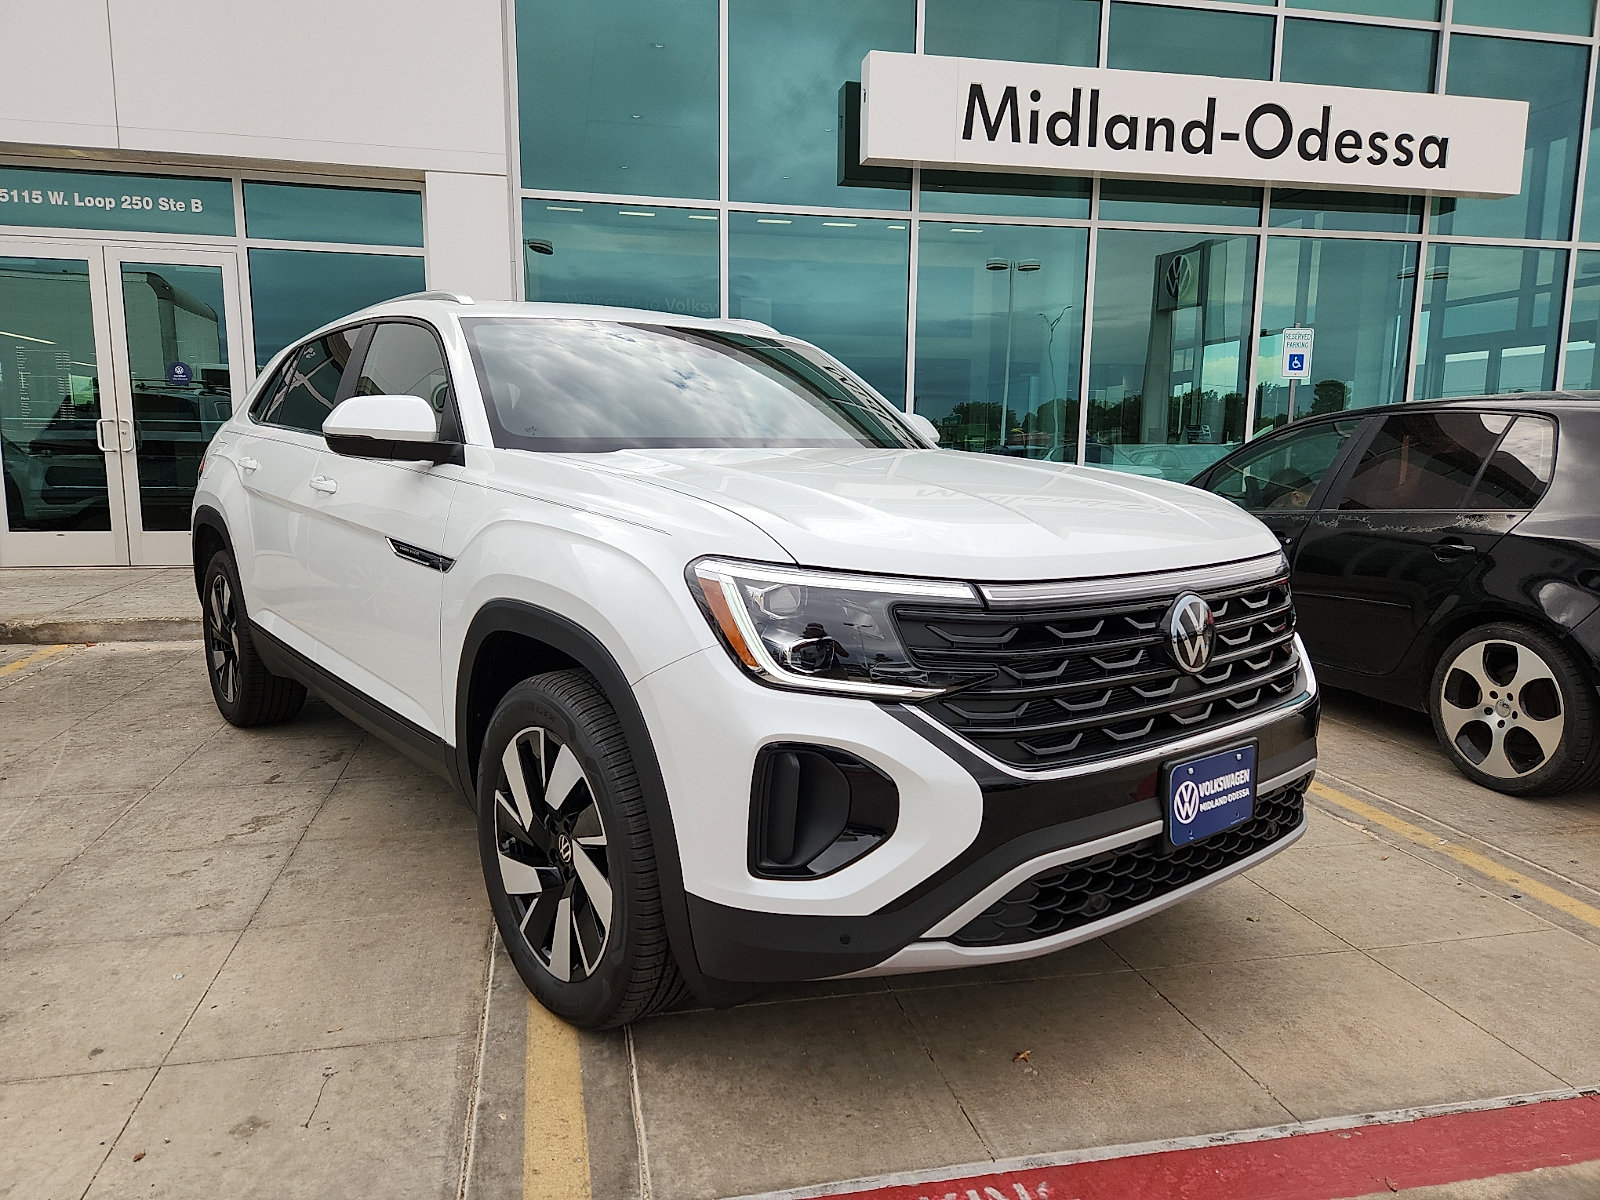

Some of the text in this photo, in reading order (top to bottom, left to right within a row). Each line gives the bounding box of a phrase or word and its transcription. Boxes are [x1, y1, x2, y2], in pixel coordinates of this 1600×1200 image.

[961, 82, 1449, 170] Midland-Odessa
[0, 188, 203, 213] 5115 W. Loop 250 Ste B
[1286, 341, 1309, 349] PARKING
[1199, 768, 1250, 798] VOLKSWAGEN
[1200, 788, 1250, 812] MIDLAND ODESSA
